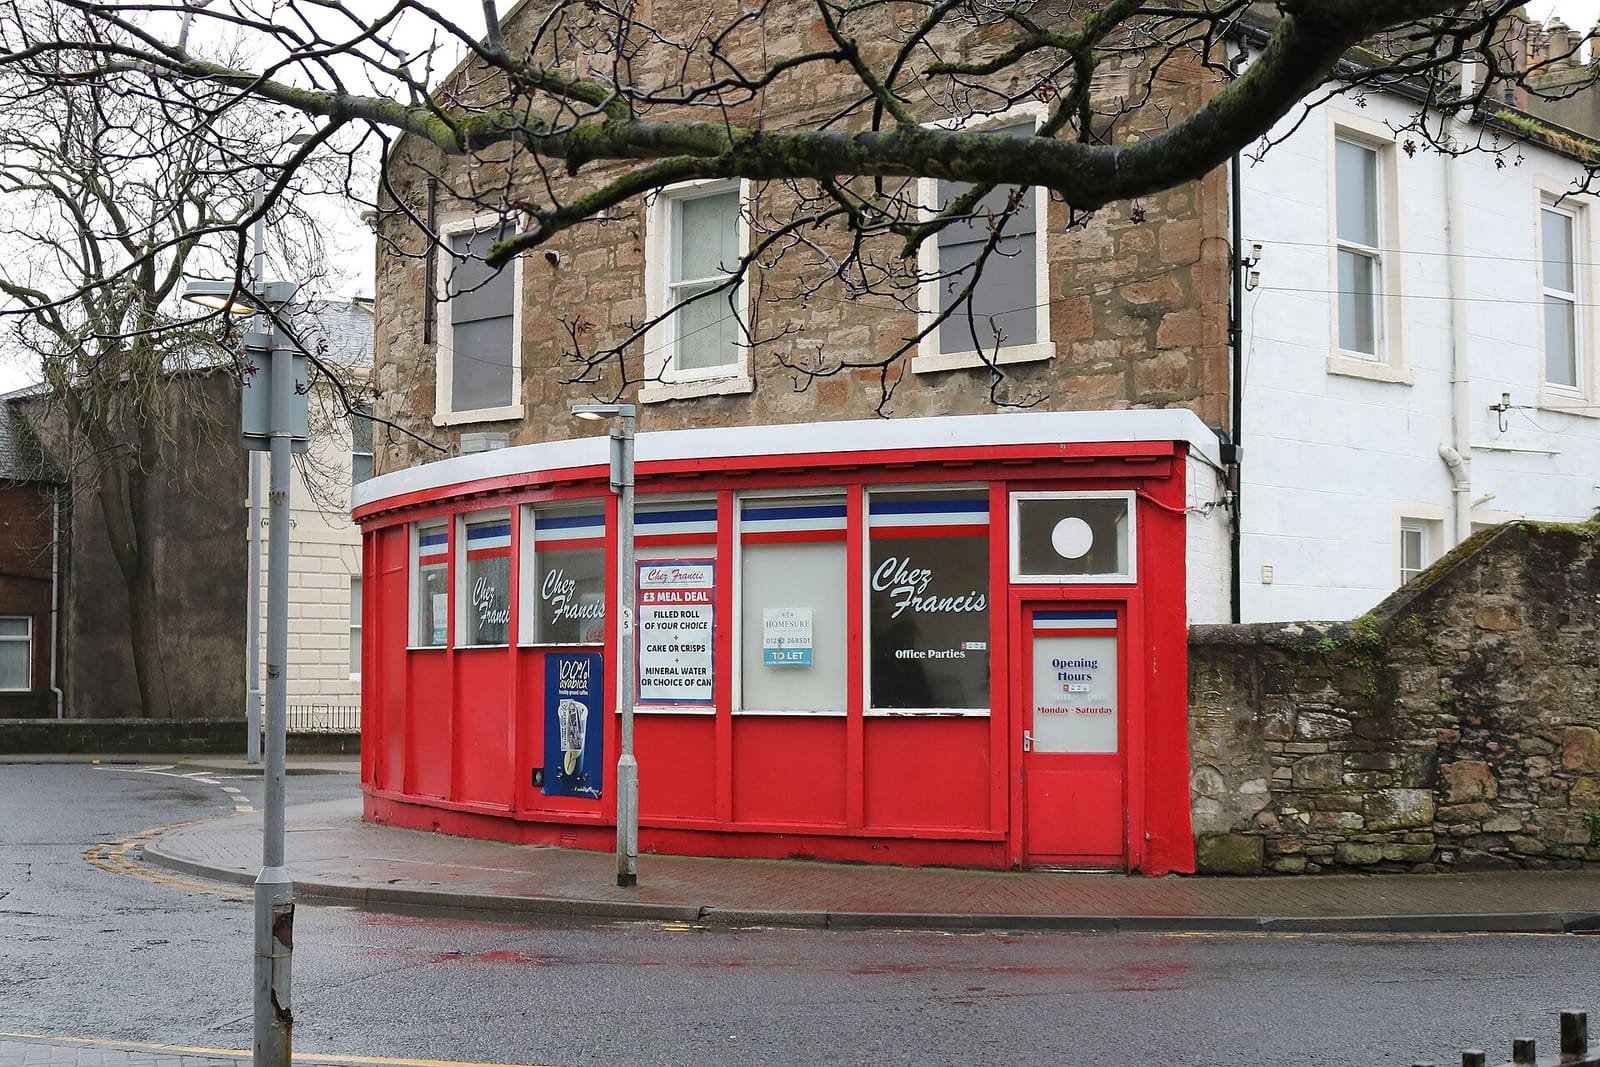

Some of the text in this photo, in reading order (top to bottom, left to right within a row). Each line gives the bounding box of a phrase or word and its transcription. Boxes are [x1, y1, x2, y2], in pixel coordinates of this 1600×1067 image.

[648, 568, 705, 585] Chez Francis
[871, 556, 933, 595] Chez
[541, 568, 577, 602] Chez
[472, 576, 496, 609] Chez
[643, 591, 709, 602] £3 MEAL DEAL
[889, 585, 988, 619] Francis
[478, 601, 511, 630] Franci
[653, 610, 700, 619] FILLED ROLL
[644, 621, 708, 630] OF YOUR CHOICE
[766, 620, 809, 628] HOMESURE
[646, 644, 706, 653] CAKE OR CRISPS
[895, 648, 966, 659] Office Parties
[772, 651, 804, 660] TO LET
[1052, 658, 1098, 669] Opening
[645, 667, 707, 675] MINERAL WATER
[1058, 672, 1092, 681] Hours
[559, 679, 588, 689] arabica
[641, 678, 712, 687] OR CHOICE OF CAN
[1075, 707, 1113, 715] Saturday
